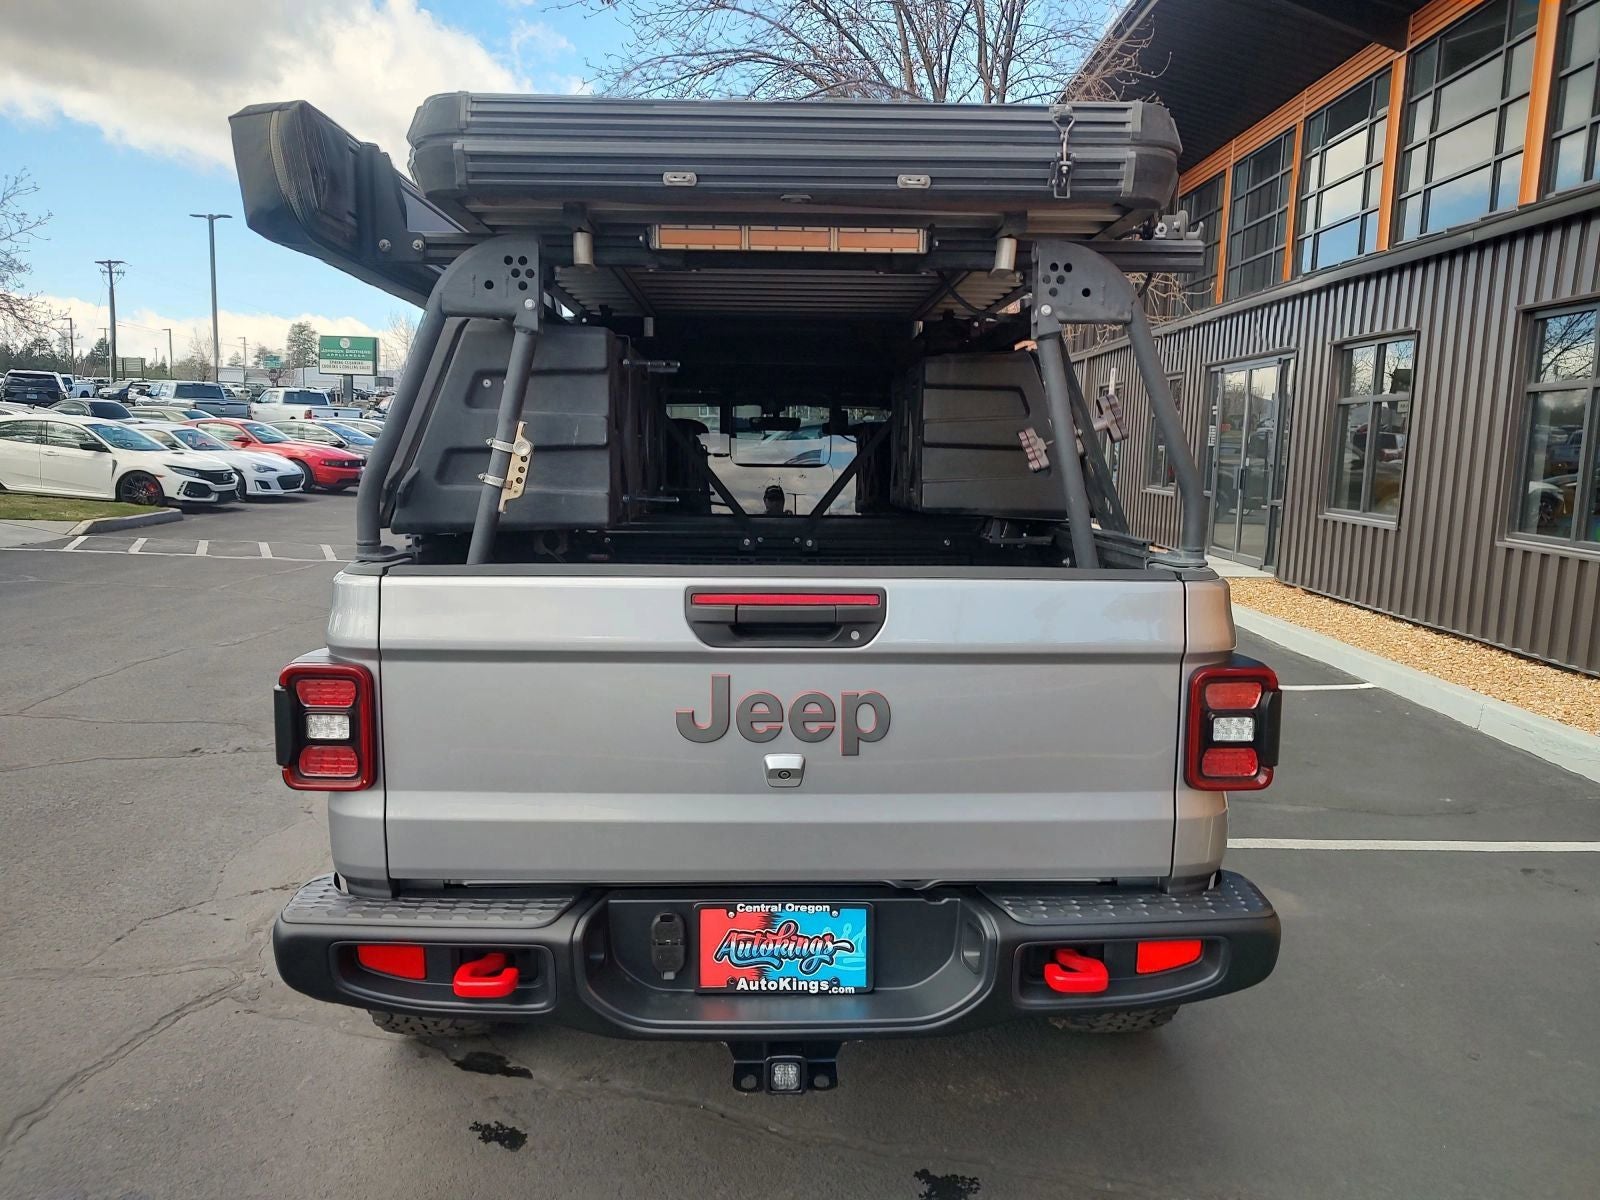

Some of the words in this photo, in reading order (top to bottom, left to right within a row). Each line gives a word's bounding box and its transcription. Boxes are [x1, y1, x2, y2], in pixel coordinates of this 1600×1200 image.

[675, 673, 892, 757] Jeep
[736, 903, 782, 913] Central
[785, 903, 831, 914] Oregon
[736, 977, 856, 995] AutoKings.com
